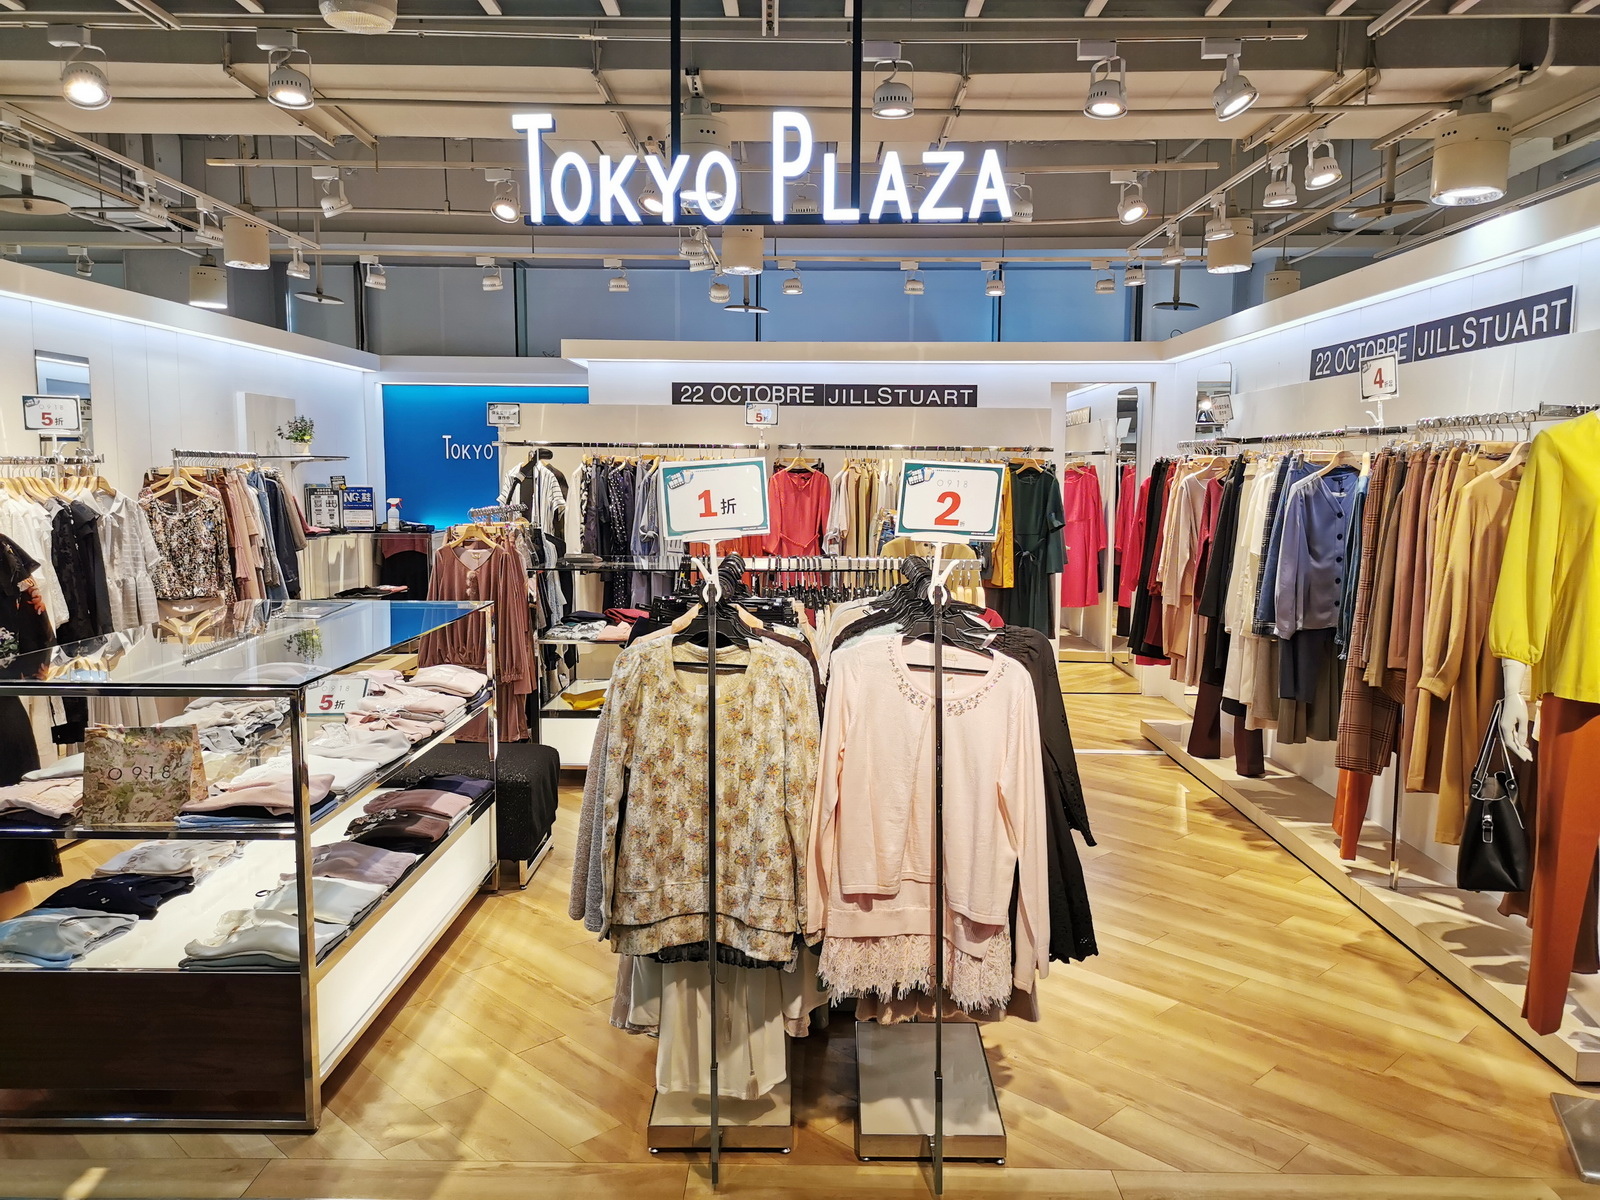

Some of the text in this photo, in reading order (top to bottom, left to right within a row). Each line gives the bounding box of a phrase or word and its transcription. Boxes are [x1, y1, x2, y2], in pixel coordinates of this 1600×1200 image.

[512, 111, 1013, 224] TOKYO PLAZA
[1417, 298, 1568, 357] JILLSTUART
[1315, 351, 1332, 376] 22
[680, 385, 815, 404] 22 OCTOBRE
[828, 387, 974, 405] JILLSTUART
[442, 434, 494, 460] TOKYO
